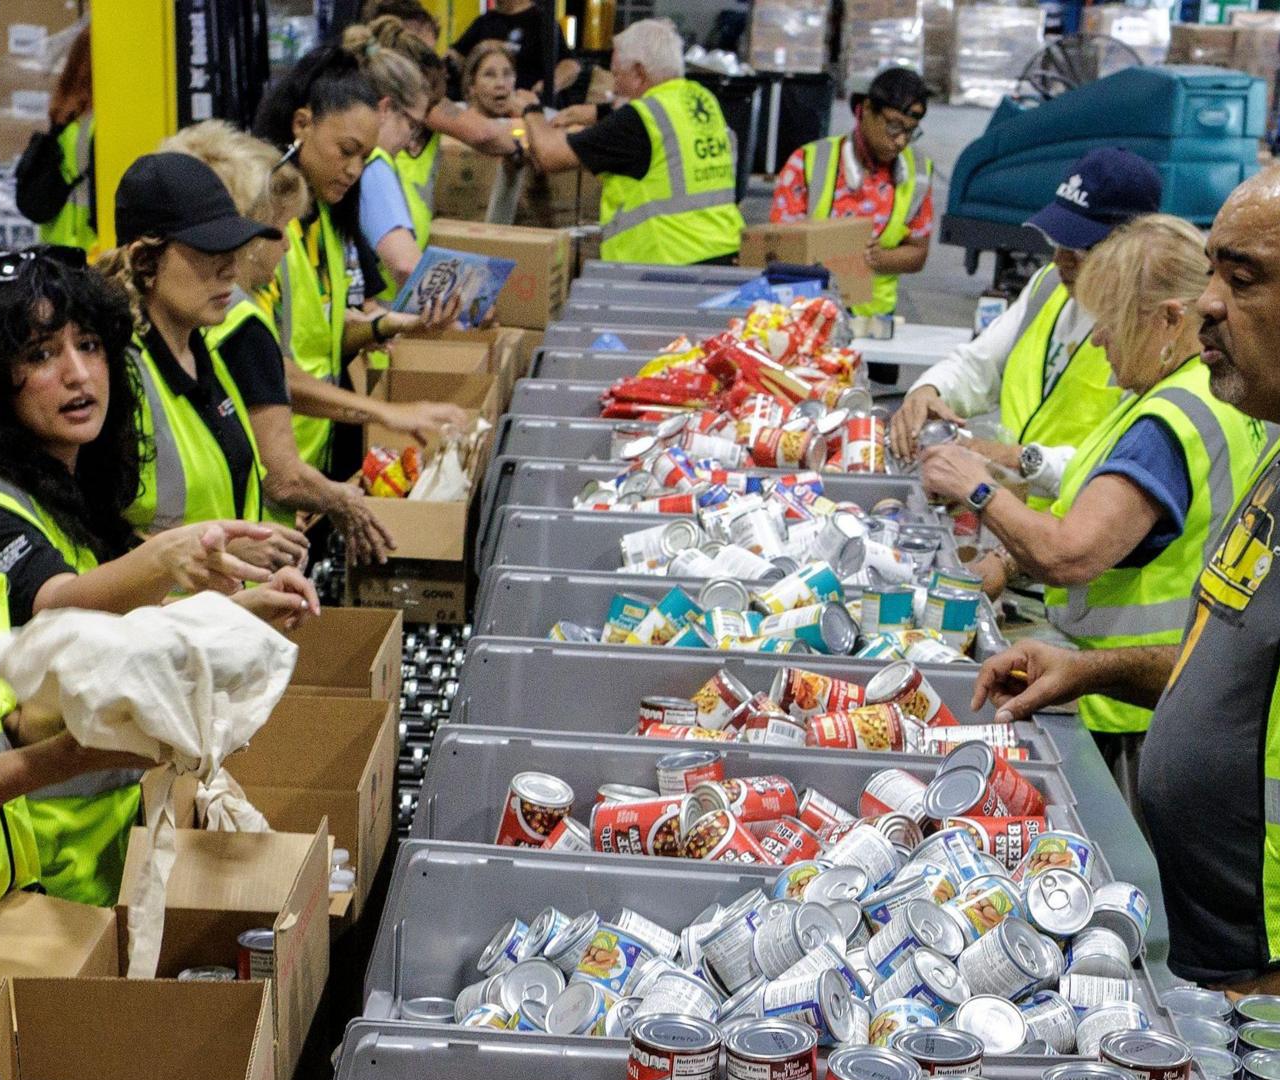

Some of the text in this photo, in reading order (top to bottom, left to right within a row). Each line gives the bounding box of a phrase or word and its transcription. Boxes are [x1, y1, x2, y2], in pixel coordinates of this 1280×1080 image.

[784, 1060, 800, 1070] Mini
[772, 1070, 789, 1080] Beef
[937, 1066, 966, 1076] Nutrition
[1163, 1071, 1178, 1080] Mini
